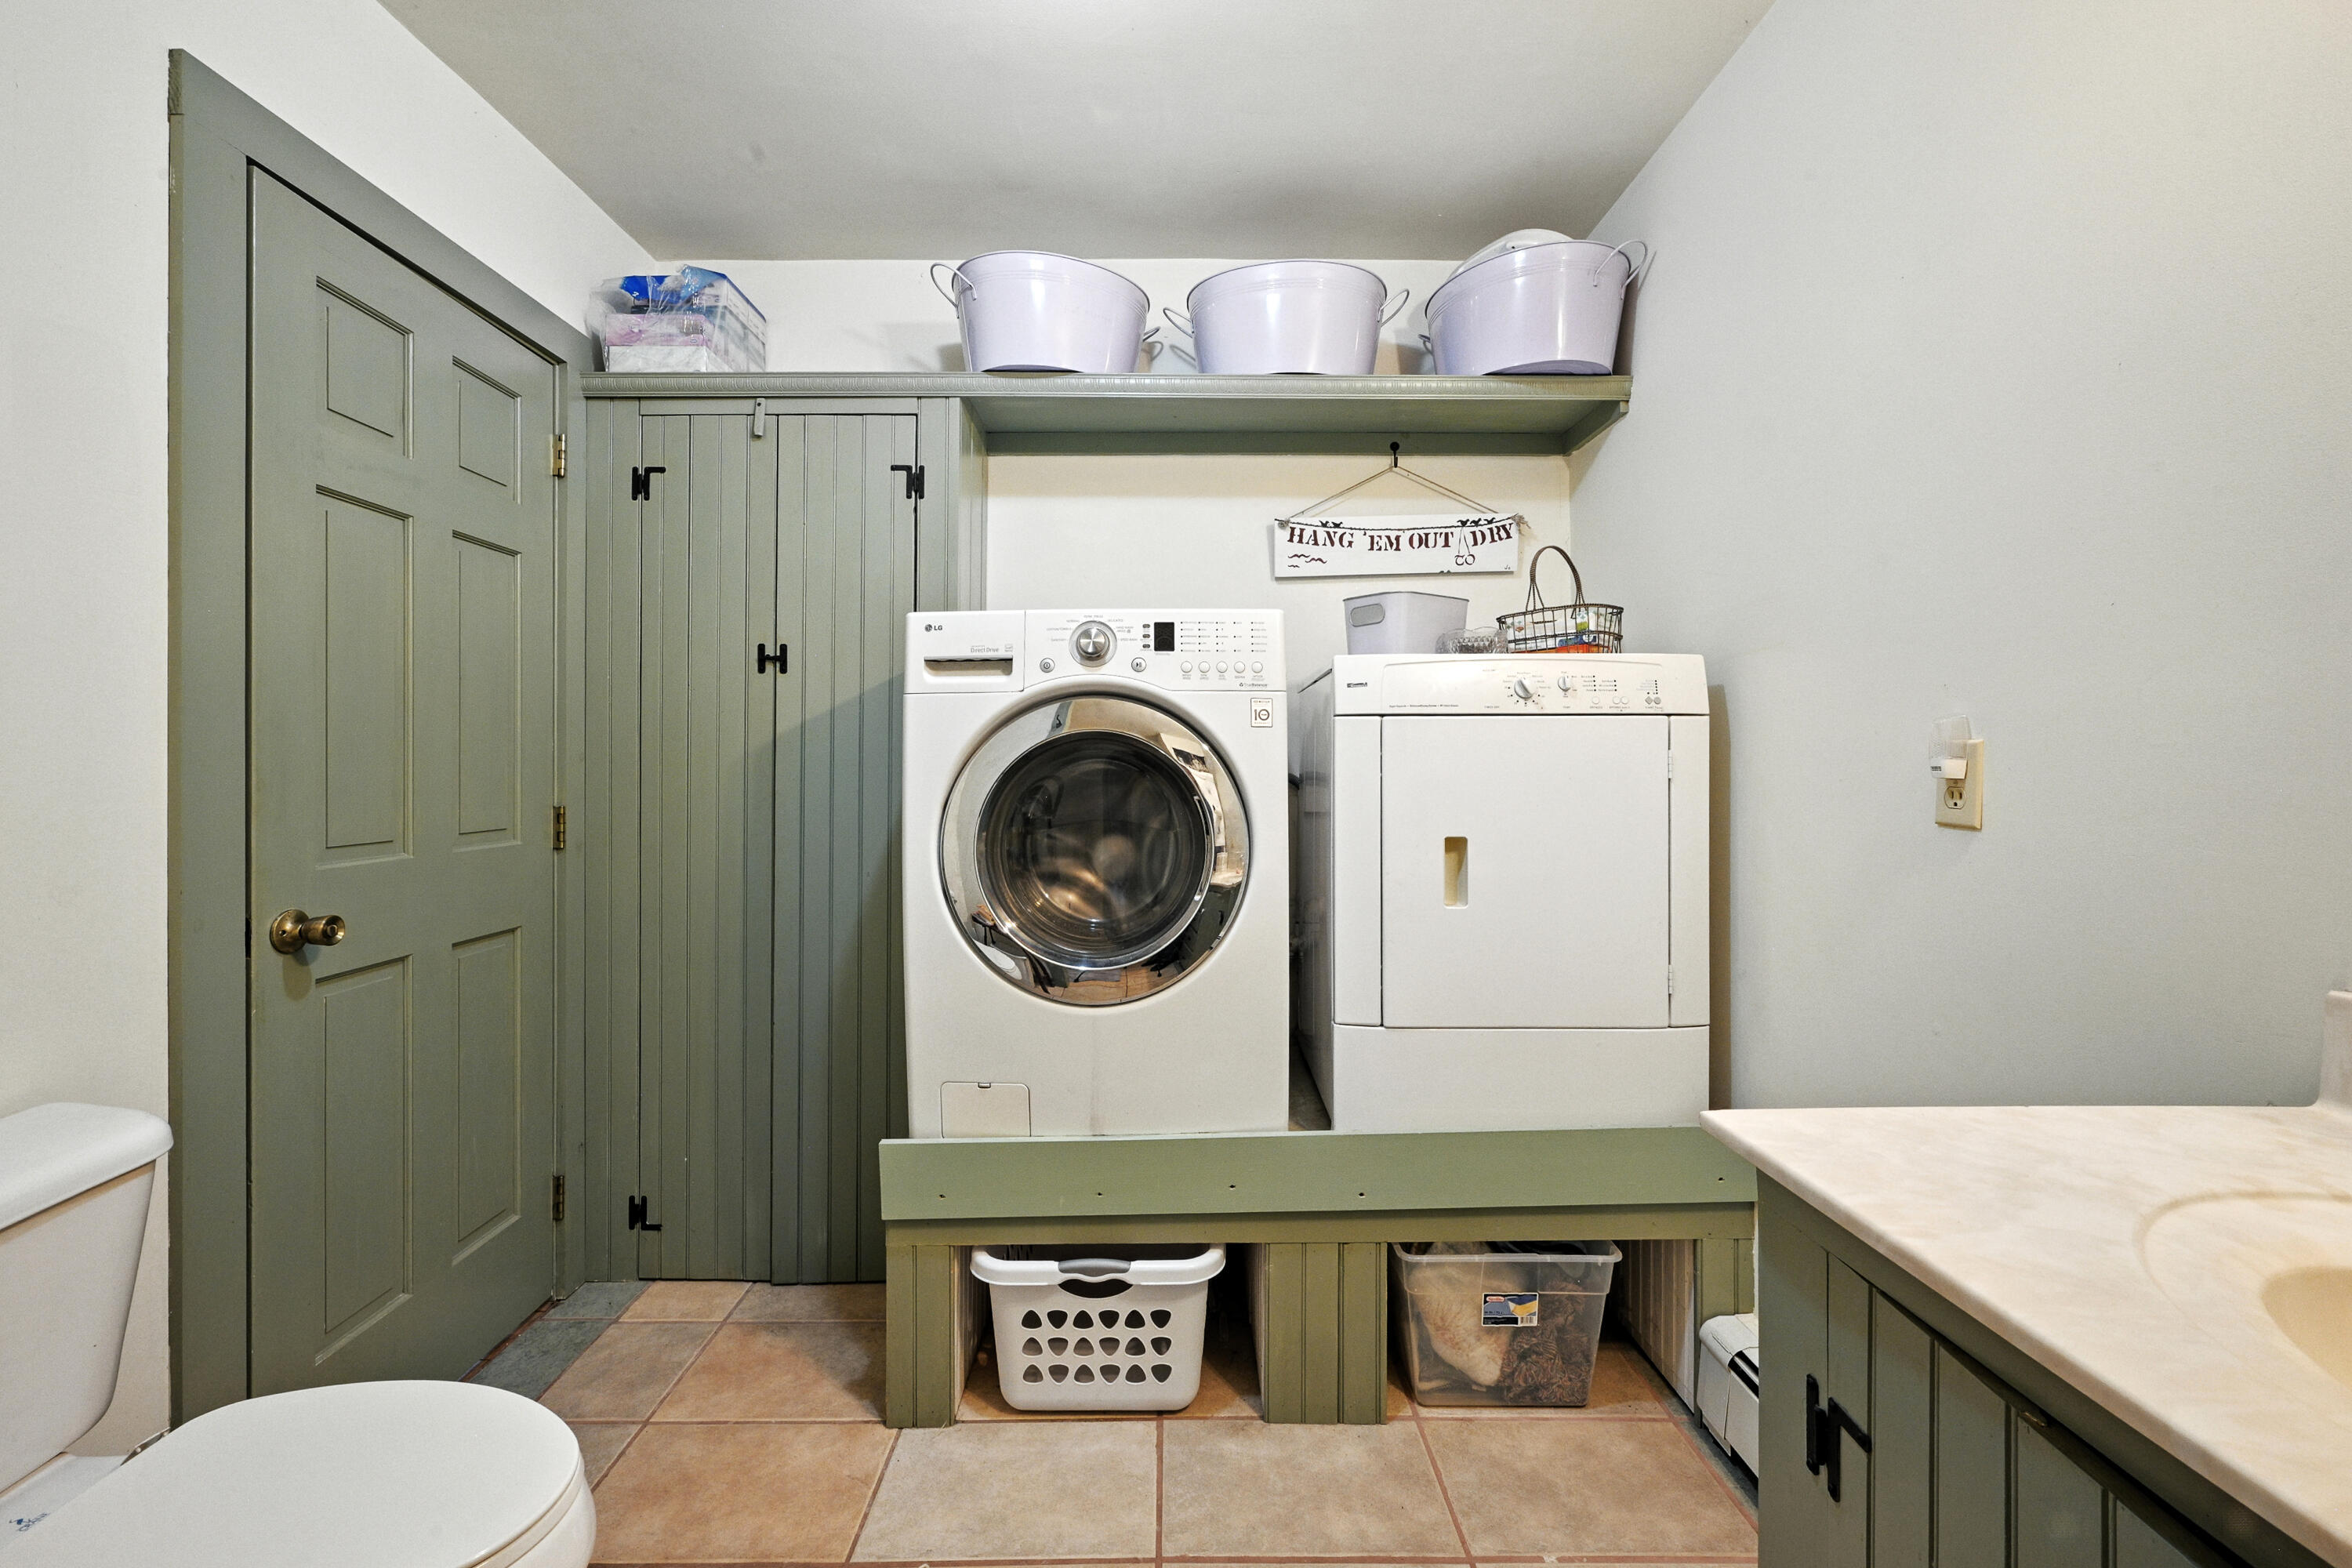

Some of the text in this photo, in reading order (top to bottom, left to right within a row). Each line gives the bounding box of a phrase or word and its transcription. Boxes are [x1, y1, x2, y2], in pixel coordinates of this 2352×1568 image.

[1287, 526, 1355, 549] HANG
[1408, 532, 1454, 550] OUT
[1469, 522, 1514, 547] DRY
[1454, 554, 1475, 566] TO
